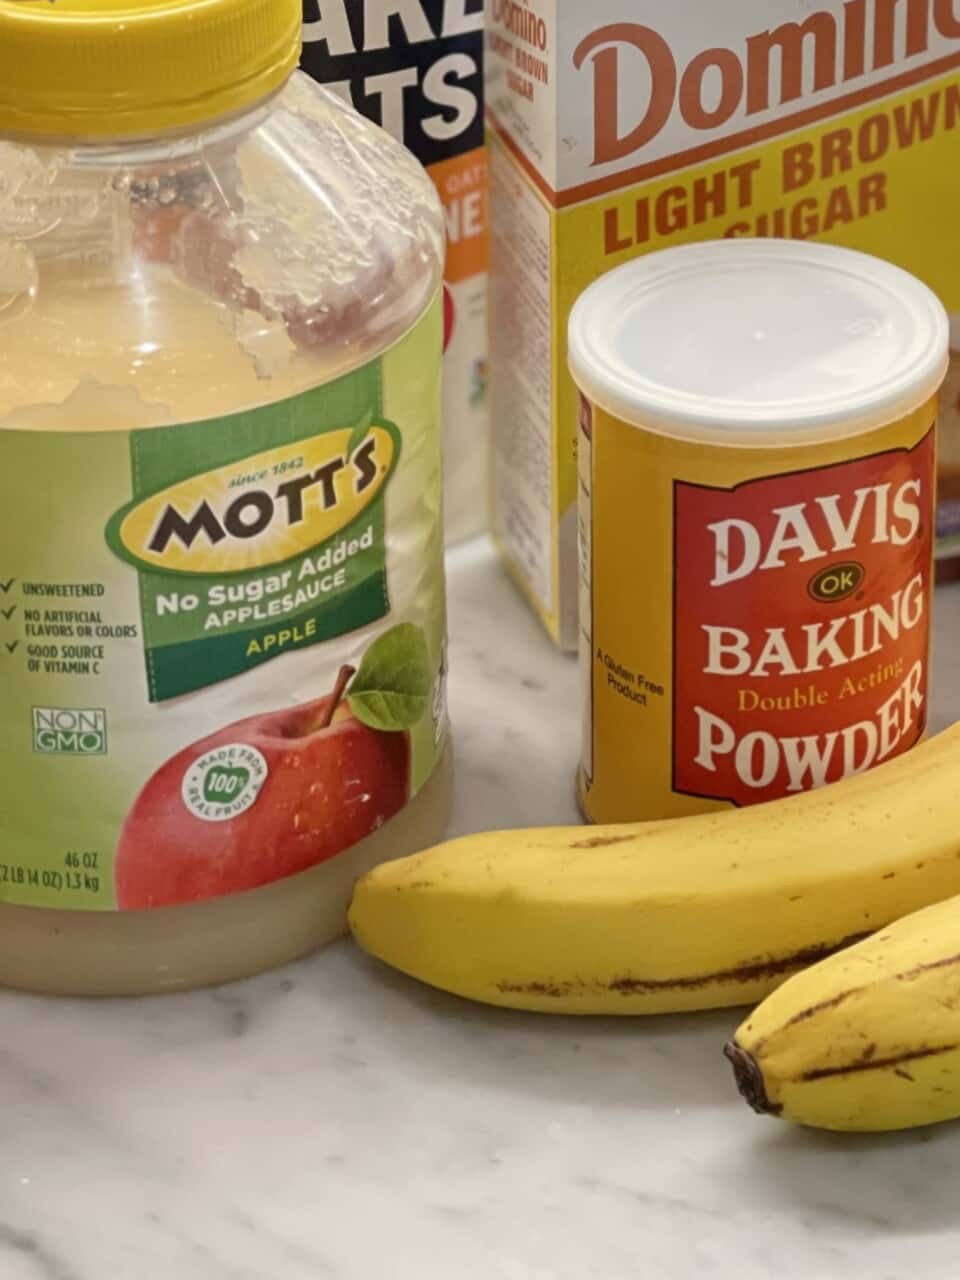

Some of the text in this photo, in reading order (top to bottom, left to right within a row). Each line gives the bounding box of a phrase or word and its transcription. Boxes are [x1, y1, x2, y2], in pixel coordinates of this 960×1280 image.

[515, 47, 548, 84] BROWN
[603, 159, 762, 255] LIGHT
[228, 457, 305, 489] since 1842
[148, 436, 377, 553] MOTT'S
[706, 477, 923, 587] DAVIS
[155, 525, 374, 617] No Sugar Added
[819, 571, 854, 595] OK
[23, 582, 105, 598] UNSWEETENED
[204, 568, 345, 630] APPLESAUCE
[24, 609, 103, 623] NO ARTIFICIAL
[25, 624, 138, 638] FLAVORS OR COLORS
[701, 574, 924, 677] BAKING
[27, 644, 105, 659] GOOD SOURCE
[246, 618, 317, 656] APPLE
[28, 660, 100, 674] OF VITAMIN C
[604, 653, 635, 684] Gluten
[637, 673, 665, 697] Free
[607, 672, 648, 707] Product
[738, 657, 905, 712] Double Acting
[36, 709, 98, 731] NON
[694, 661, 924, 792] POWDER
[37, 730, 102, 752] GMO
[197, 748, 263, 776] MADE FROM
[189, 787, 252, 817] REAL FRUIT
[65, 851, 99, 869] 46 OZ
[11, 866, 24, 884] LB
[27, 868, 39, 887] 14
[42, 870, 63, 891] OZ)
[66, 871, 82, 889] 1.3
[84, 872, 100, 892] kg
